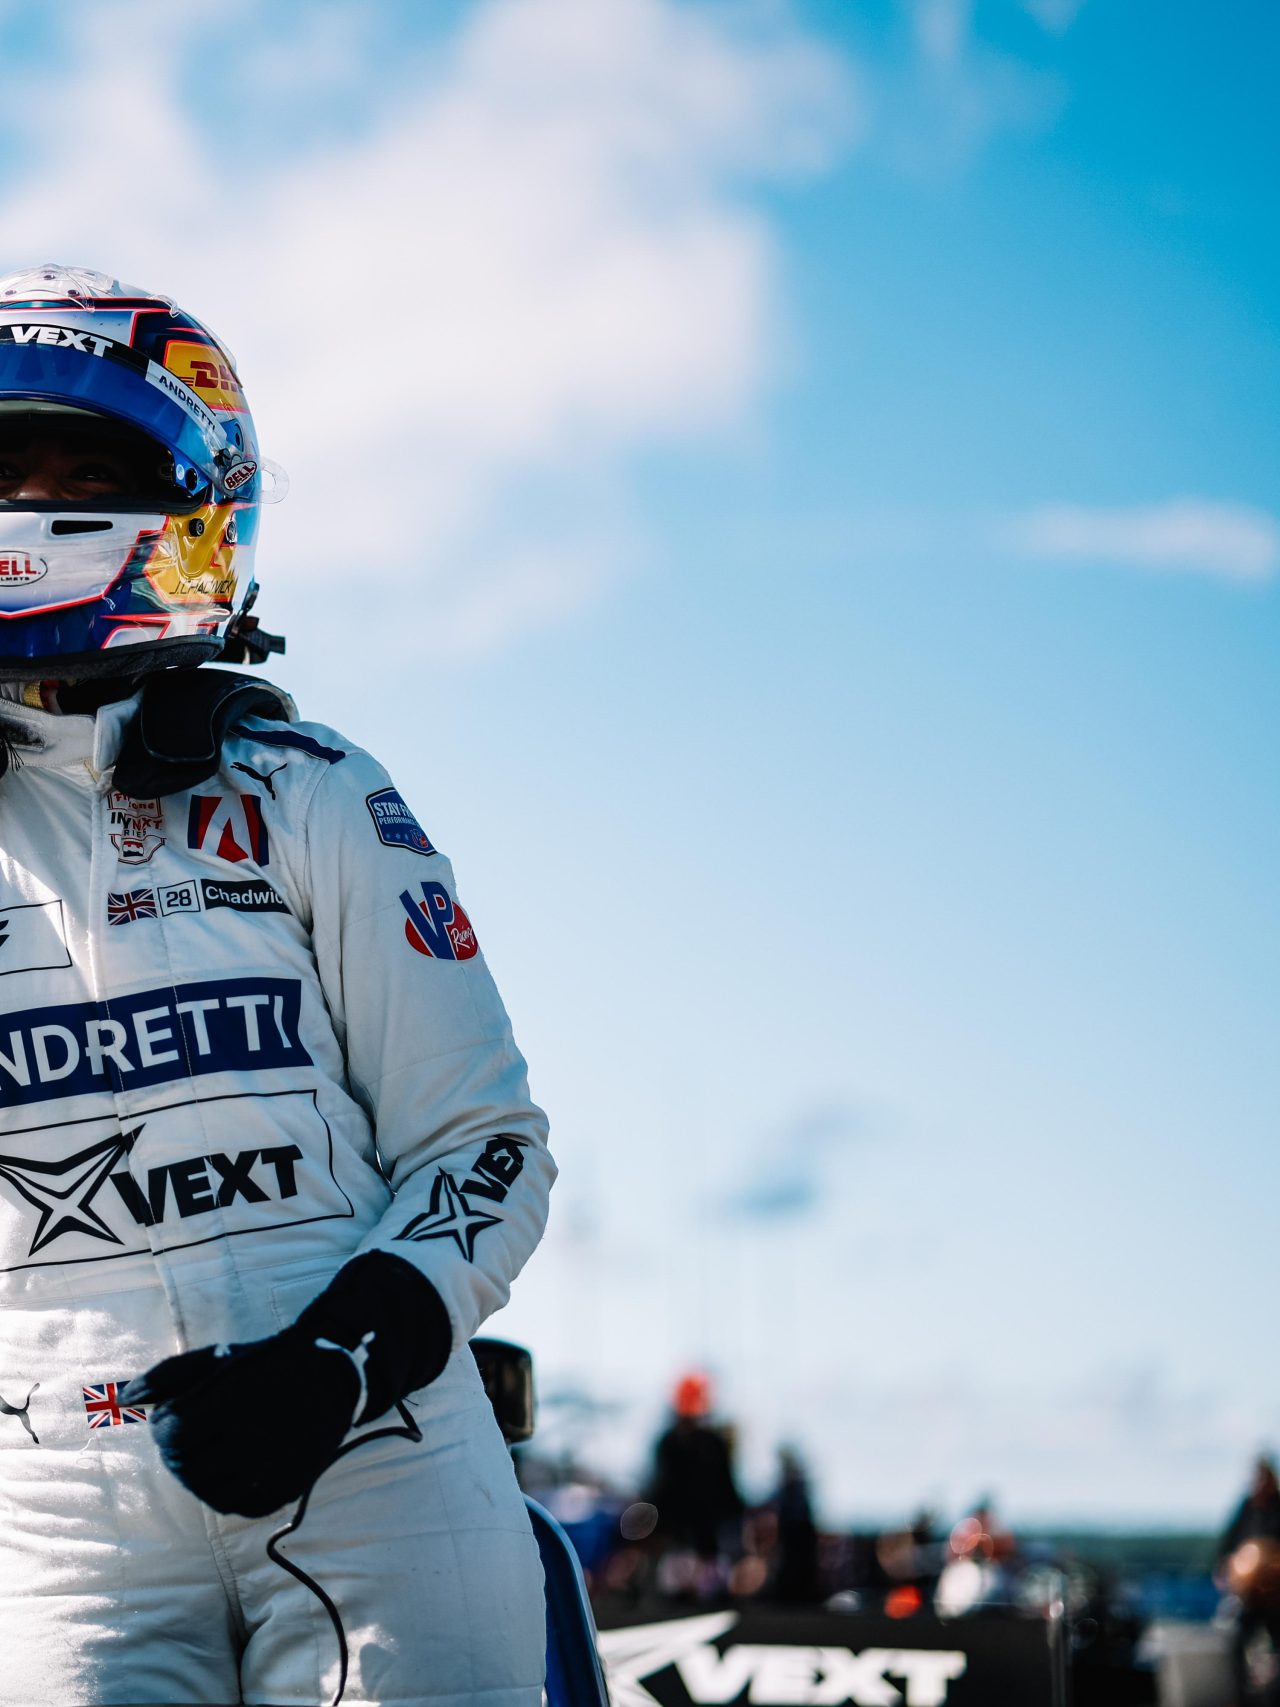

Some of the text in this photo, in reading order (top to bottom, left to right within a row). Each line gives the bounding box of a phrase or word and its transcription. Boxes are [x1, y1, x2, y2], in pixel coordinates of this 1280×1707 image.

[11, 325, 114, 358] VEXT
[158, 374, 216, 432] ANDRETTI
[225, 465, 255, 489] BELL
[373, 801, 401, 817] STAY
[166, 888, 193, 908] 28
[399, 881, 455, 961] VP
[108, 1143, 304, 1228] VEXT
[675, 1642, 968, 1706] VEXT
